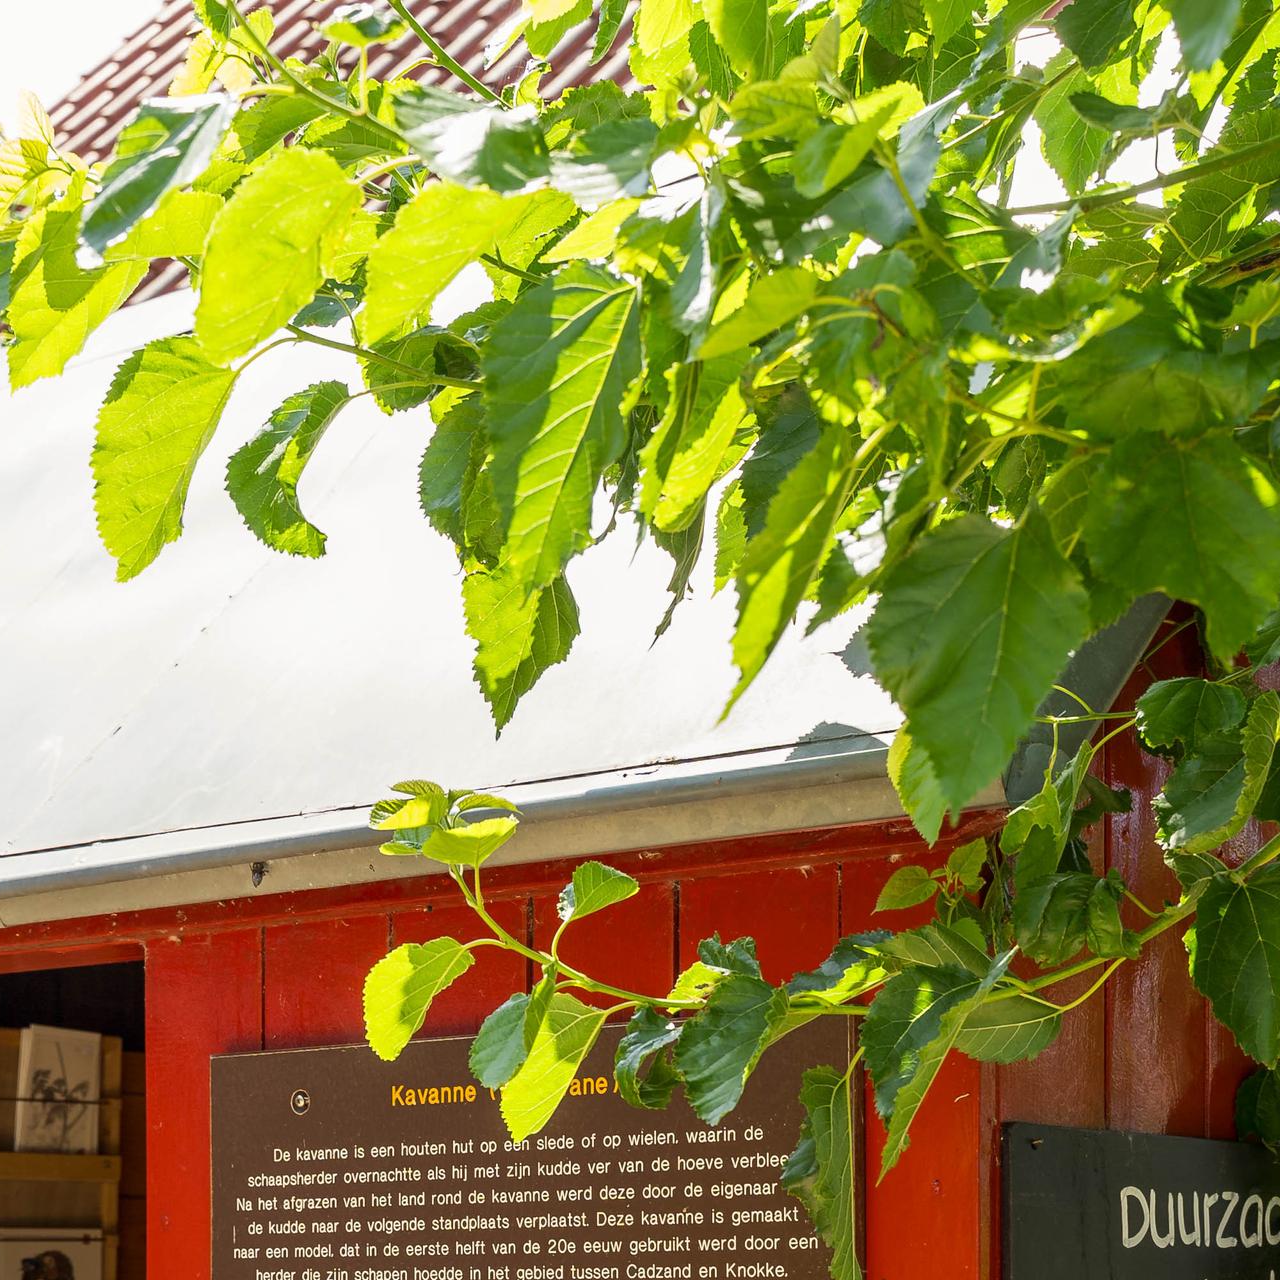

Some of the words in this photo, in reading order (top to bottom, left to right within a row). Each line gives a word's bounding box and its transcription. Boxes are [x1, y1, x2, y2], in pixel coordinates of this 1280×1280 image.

[391, 1084, 477, 1106] Kavanne
[273, 1148, 292, 1163] De
[296, 1147, 349, 1161] kavanne
[353, 1144, 365, 1159] is
[370, 1145, 395, 1159] een
[400, 1140, 447, 1157] houten
[452, 1138, 474, 1154] hut
[479, 1140, 498, 1155] op
[503, 1139, 530, 1152] een
[536, 1134, 574, 1150] slede
[581, 1132, 597, 1149] of
[602, 1134, 622, 1150] op
[685, 1129, 737, 1144] waarin
[743, 1125, 764, 1142] de
[247, 1170, 339, 1189] schaapsherder
[343, 1166, 422, 1184] overnachtte
[426, 1165, 447, 1181] als
[451, 1164, 468, 1182] hij
[473, 1163, 501, 1179] met
[506, 1164, 531, 1180] zijn
[537, 1160, 581, 1177] kudde
[587, 1161, 612, 1175] ver
[617, 1160, 644, 1174] van
[650, 1156, 671, 1172] de
[677, 1155, 724, 1171] hoeve
[730, 1152, 789, 1169] verblee
[236, 1197, 253, 1212] Na
[257, 1196, 278, 1211] het
[282, 1195, 338, 1213] afgrazen
[342, 1196, 366, 1209] van
[371, 1192, 393, 1208] het
[398, 1191, 426, 1207] land
[431, 1190, 462, 1206] rond
[467, 1189, 486, 1205] de
[491, 1188, 550, 1204] kavanne
[556, 1185, 593, 1202] werd
[599, 1184, 636, 1201] deze
[641, 1183, 677, 1199] door
[683, 1181, 704, 1198] de
[710, 1182, 779, 1200] eigenaar
[247, 1221, 264, 1235] de
[268, 1219, 306, 1235] kudde
[311, 1221, 340, 1234] naar
[344, 1218, 362, 1233] de
[366, 1216, 426, 1235] volgende
[431, 1214, 510, 1232] standplaats
[515, 1211, 590, 1231] verplaatst.
[596, 1211, 635, 1227] Deze
[641, 1209, 704, 1226] kavanne
[711, 1211, 725, 1224] is
[731, 1205, 799, 1227] gemaakt
[233, 1247, 261, 1259] naar
[265, 1246, 289, 1259] een
[339, 1242, 361, 1258] dat
[365, 1242, 378, 1257] in
[382, 1242, 400, 1257] de
[405, 1241, 450, 1257] eerste
[455, 1240, 486, 1256] helft
[491, 1242, 517, 1255] van
[522, 1239, 541, 1255] de
[547, 1238, 577, 1254] 20e
[583, 1240, 623, 1254] eeuw
[629, 1235, 691, 1256] gebruikt
[697, 1234, 737, 1252] werd
[744, 1234, 781, 1251] door
[788, 1236, 819, 1250] een
[469, 1268, 482, 1280] in
[487, 1265, 511, 1280] het
[570, 1264, 619, 1280] tussen
[625, 1263, 692, 1280] Cadzand
[698, 1265, 718, 1279] en
